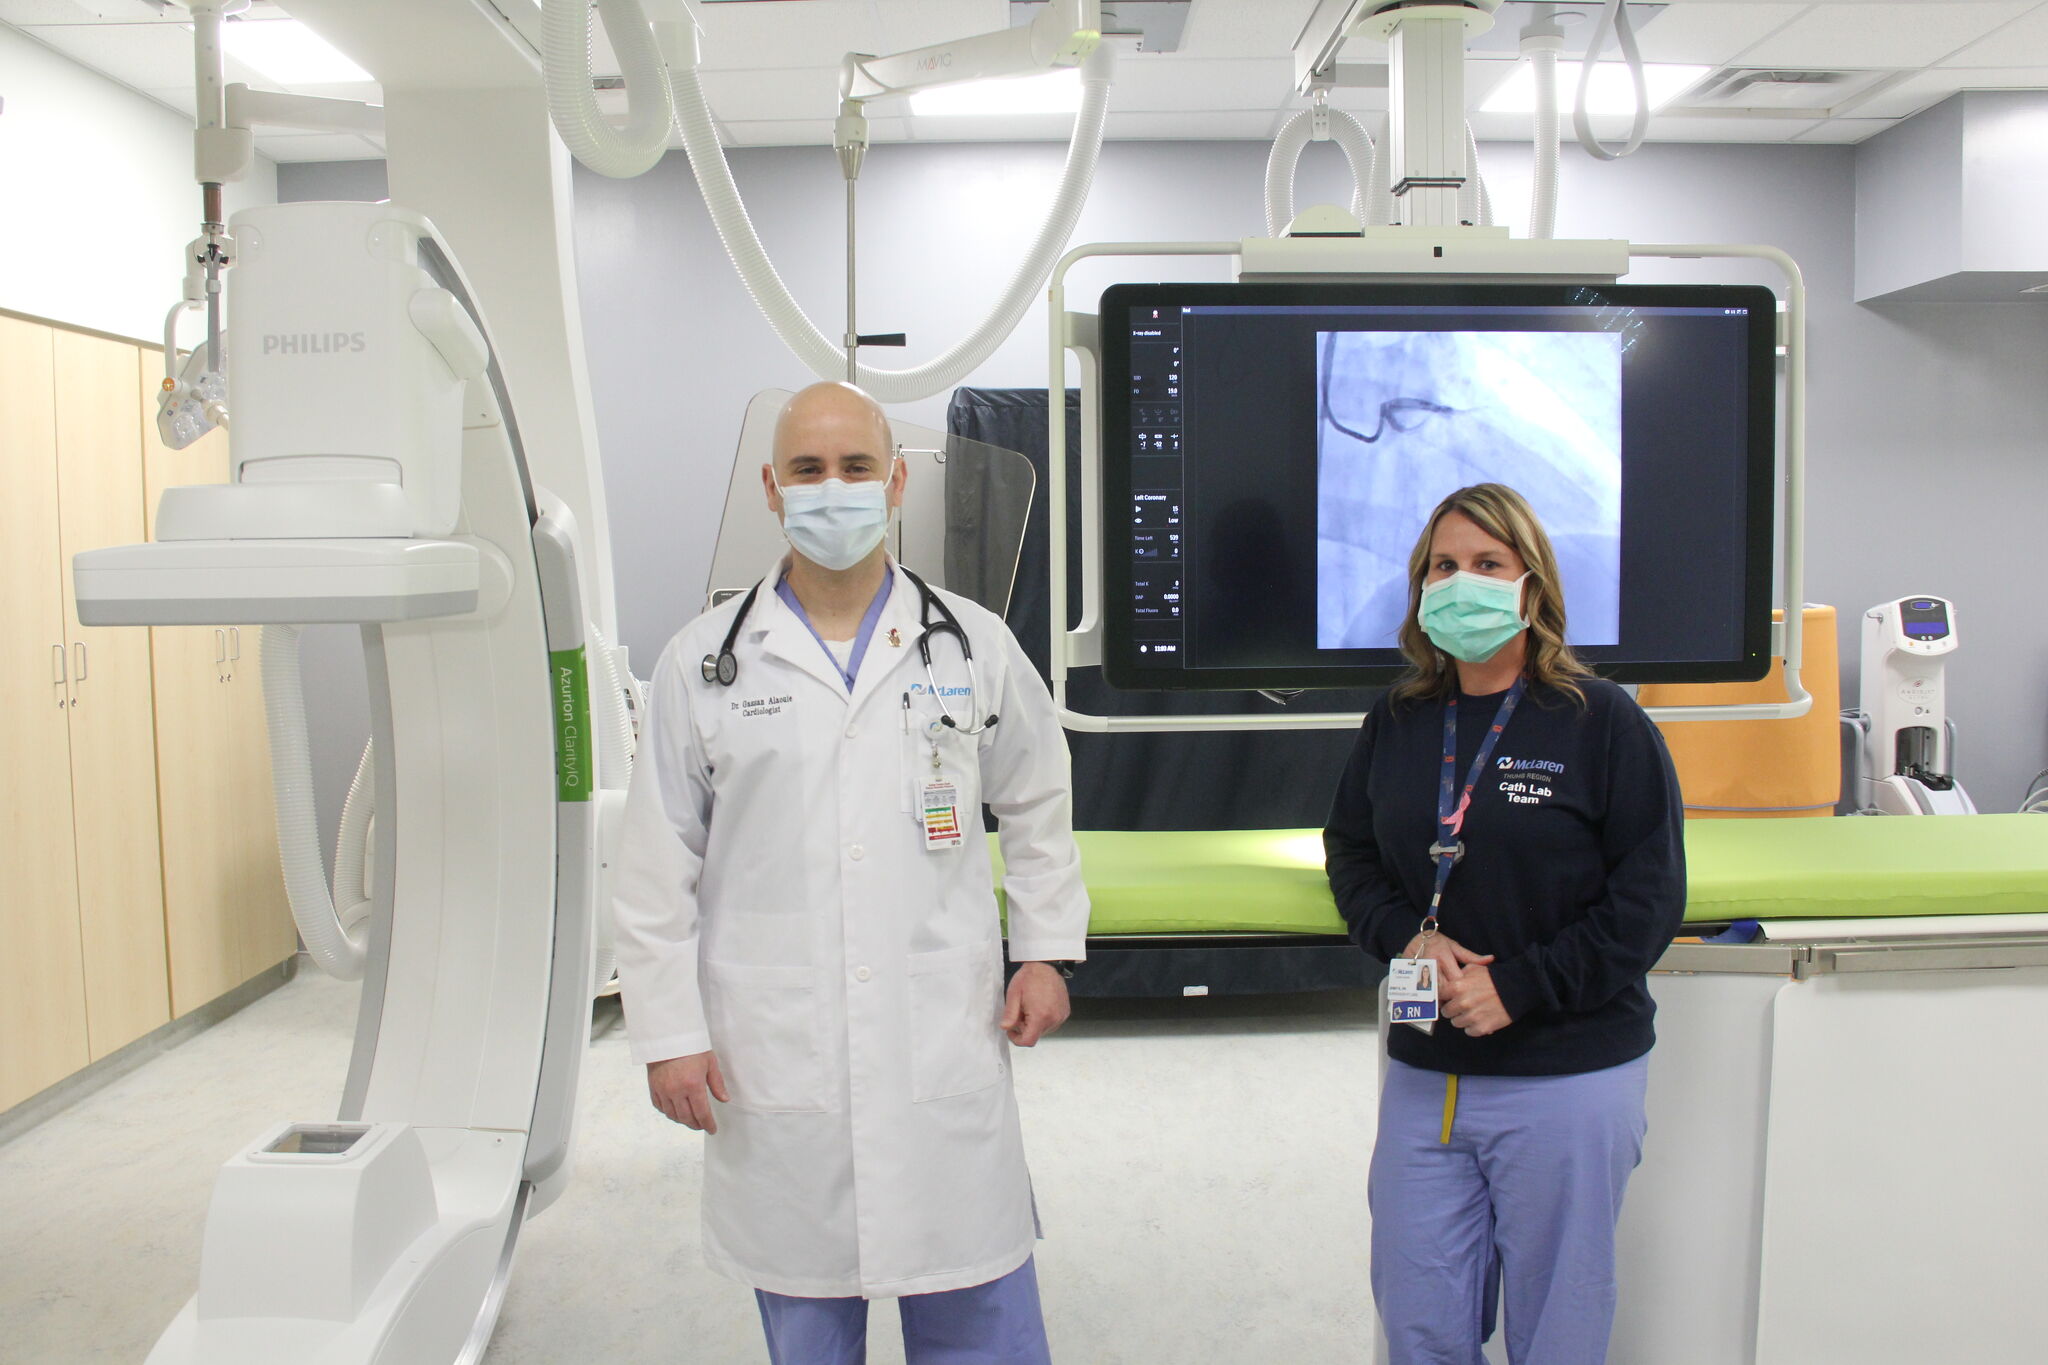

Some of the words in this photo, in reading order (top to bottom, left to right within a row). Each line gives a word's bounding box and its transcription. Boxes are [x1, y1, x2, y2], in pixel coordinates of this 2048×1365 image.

[263, 332, 366, 355] PHILIPS
[560, 667, 575, 722] Azurion
[742, 706, 781, 717] Cardiologist
[564, 725, 579, 787] ClarityIQ
[1513, 759, 1565, 774] McLaren
[1526, 773, 1552, 782] REGION
[1499, 782, 1526, 792] Cath
[1529, 784, 1552, 797] Lab
[1507, 792, 1540, 804] Team
[1407, 1007, 1421, 1018] RN
